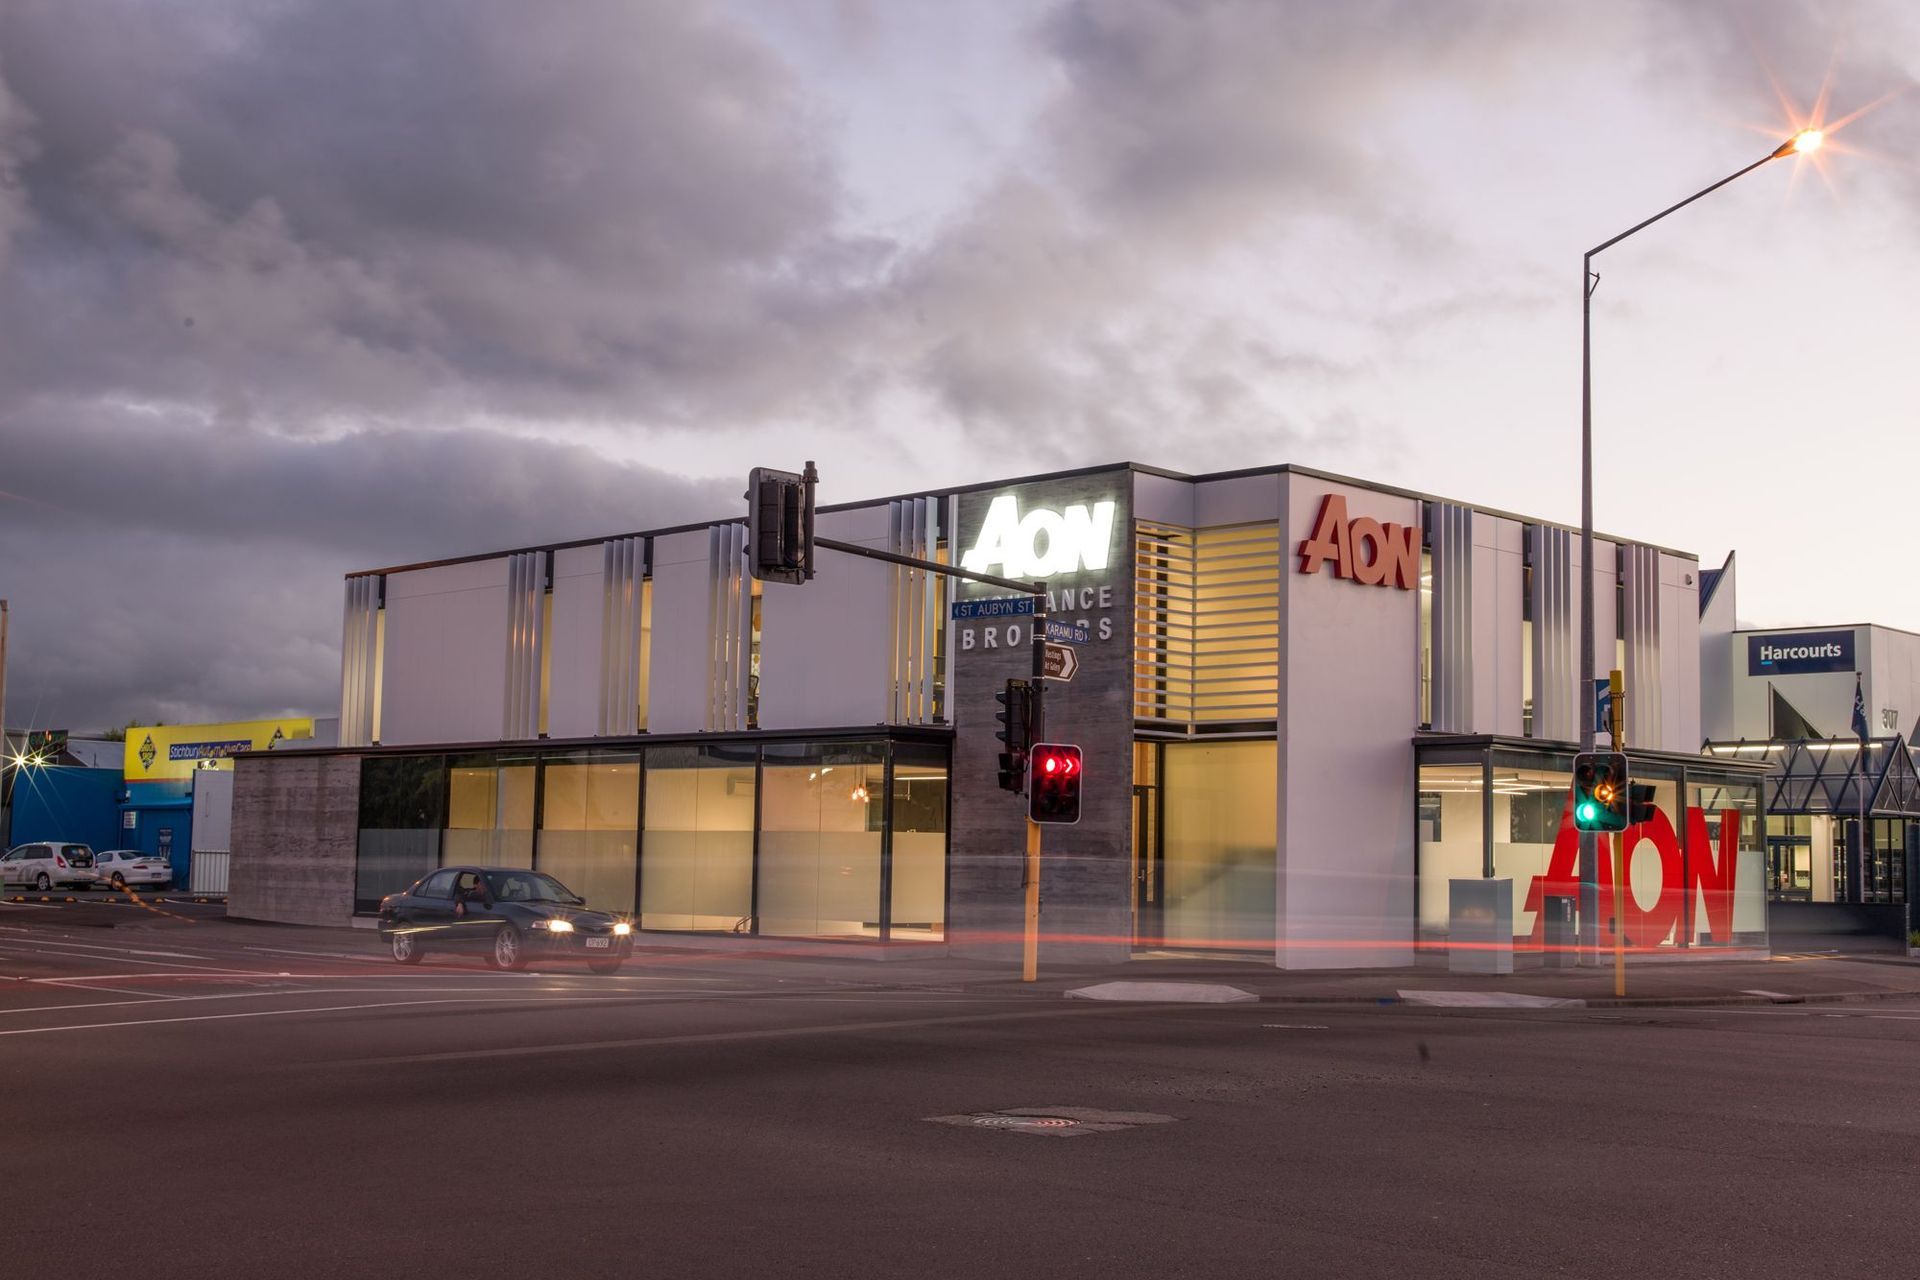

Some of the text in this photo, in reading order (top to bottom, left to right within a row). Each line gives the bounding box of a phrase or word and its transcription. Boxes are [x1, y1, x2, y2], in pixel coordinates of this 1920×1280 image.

[960, 495, 1115, 583] AON
[1297, 493, 1422, 590] AON
[960, 600, 1031, 616] ST AUBYN ST
[962, 617, 1113, 650] BROS
[1045, 622, 1084, 641] KARAMU RD
[1760, 643, 1842, 660] Harcourts
[1523, 775, 1740, 948] AON
